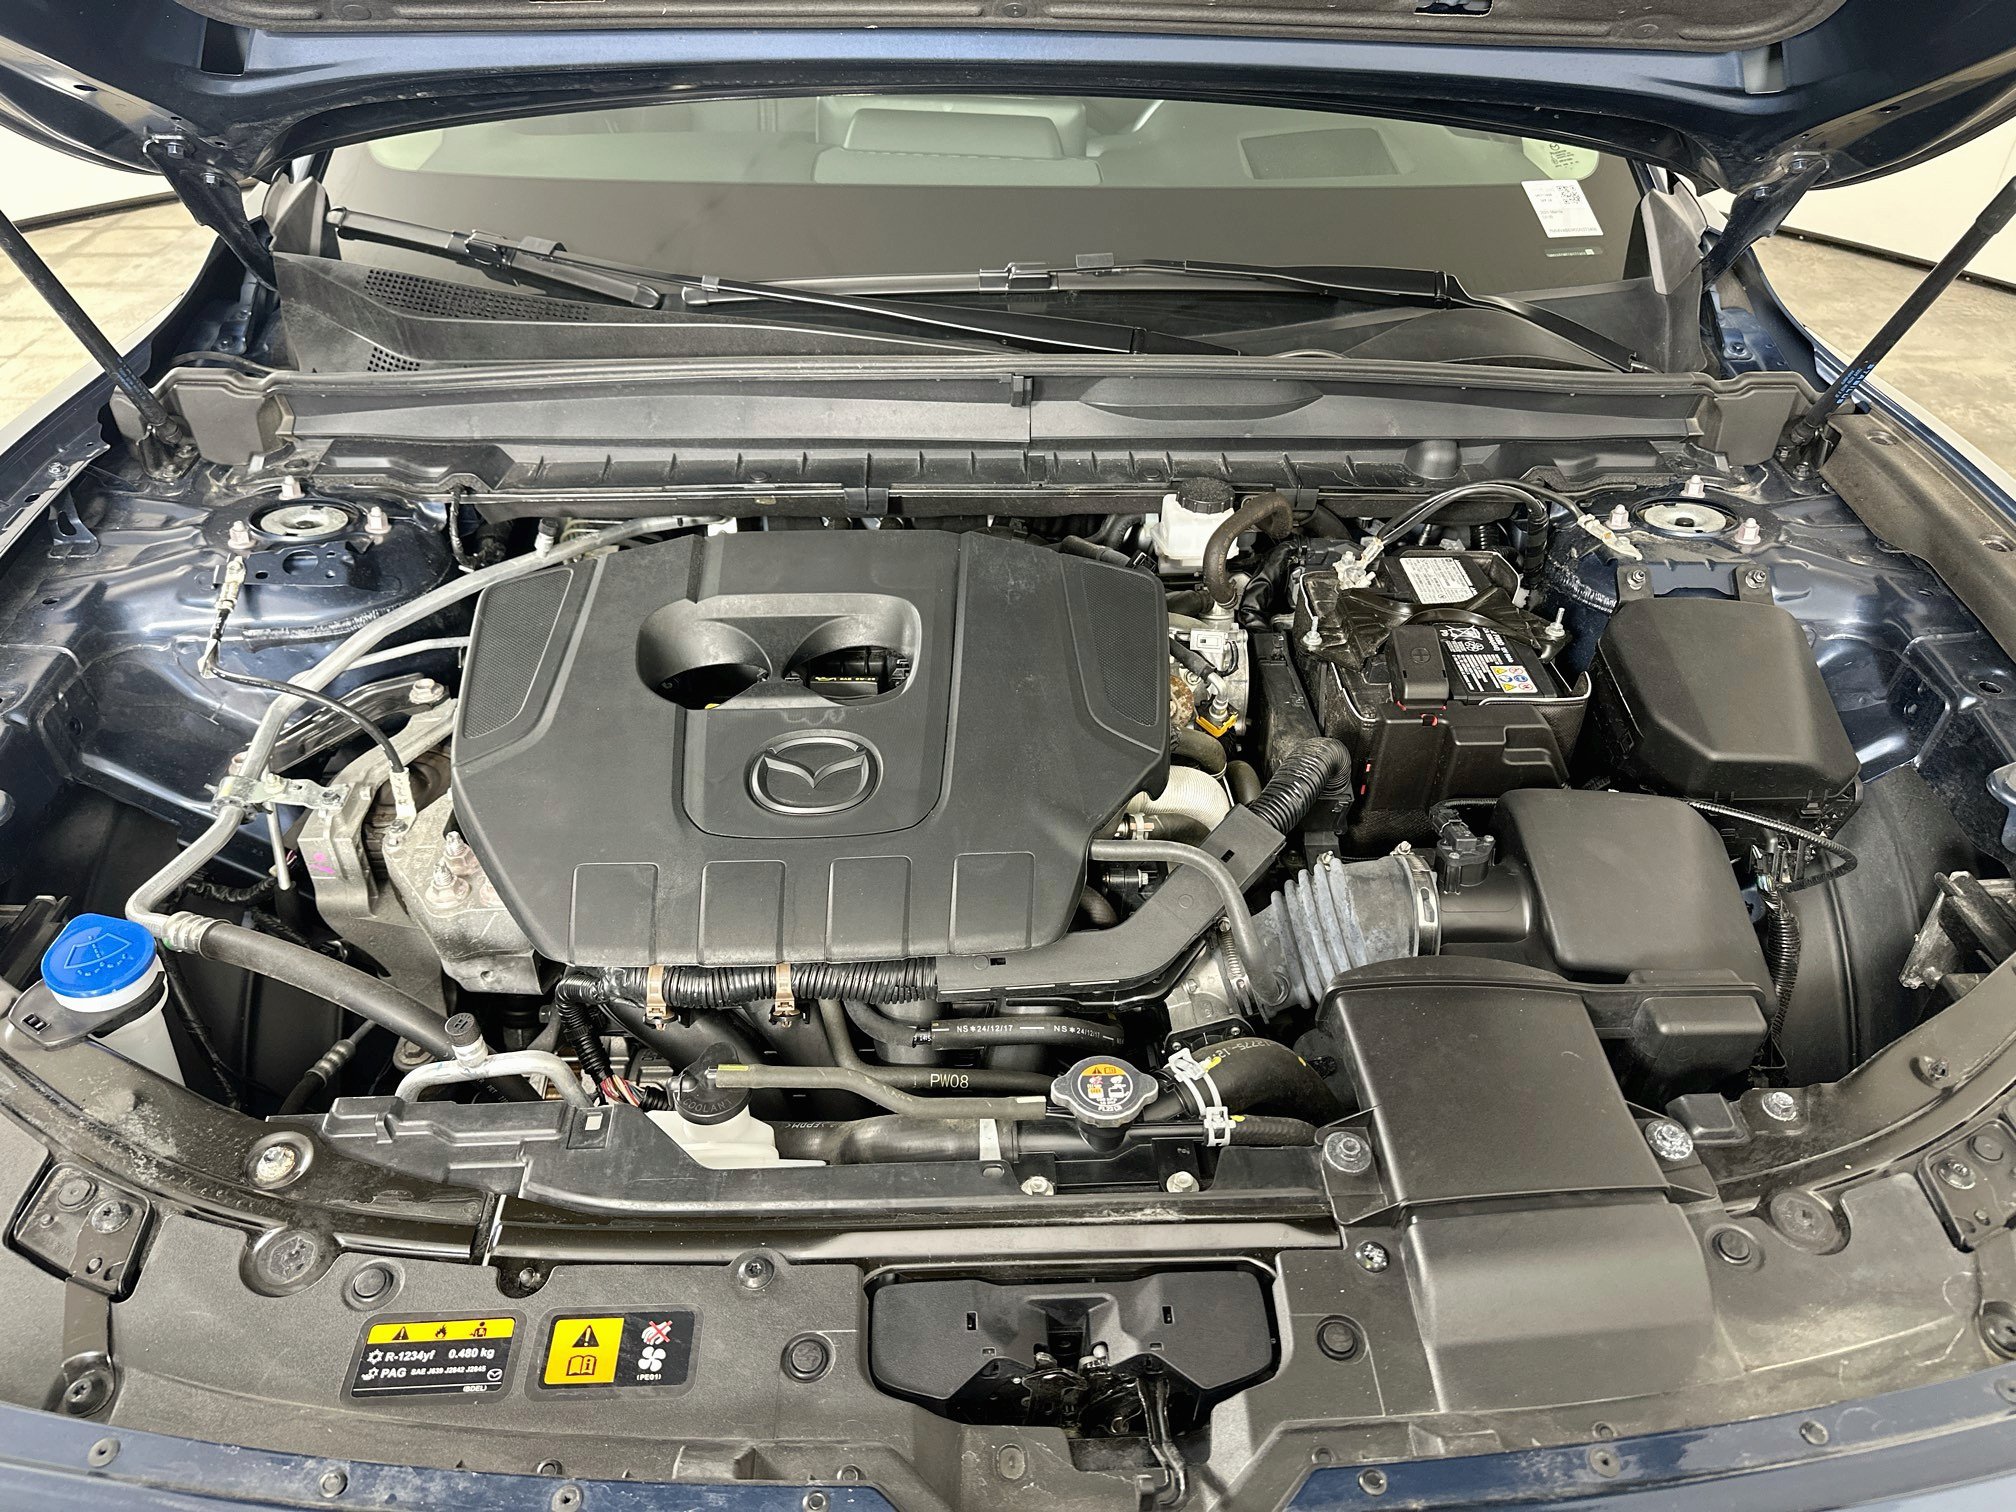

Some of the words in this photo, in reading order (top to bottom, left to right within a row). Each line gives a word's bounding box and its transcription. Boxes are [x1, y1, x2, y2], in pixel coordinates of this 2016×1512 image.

[930, 1074, 970, 1089] PW08
[682, 1098, 733, 1114] COOLANT
[384, 1349, 436, 1363] R-1234yf
[447, 1348, 478, 1360] 0.480
[480, 1347, 496, 1360] kg
[380, 1367, 407, 1379] PAG
[410, 1368, 427, 1376] SAE
